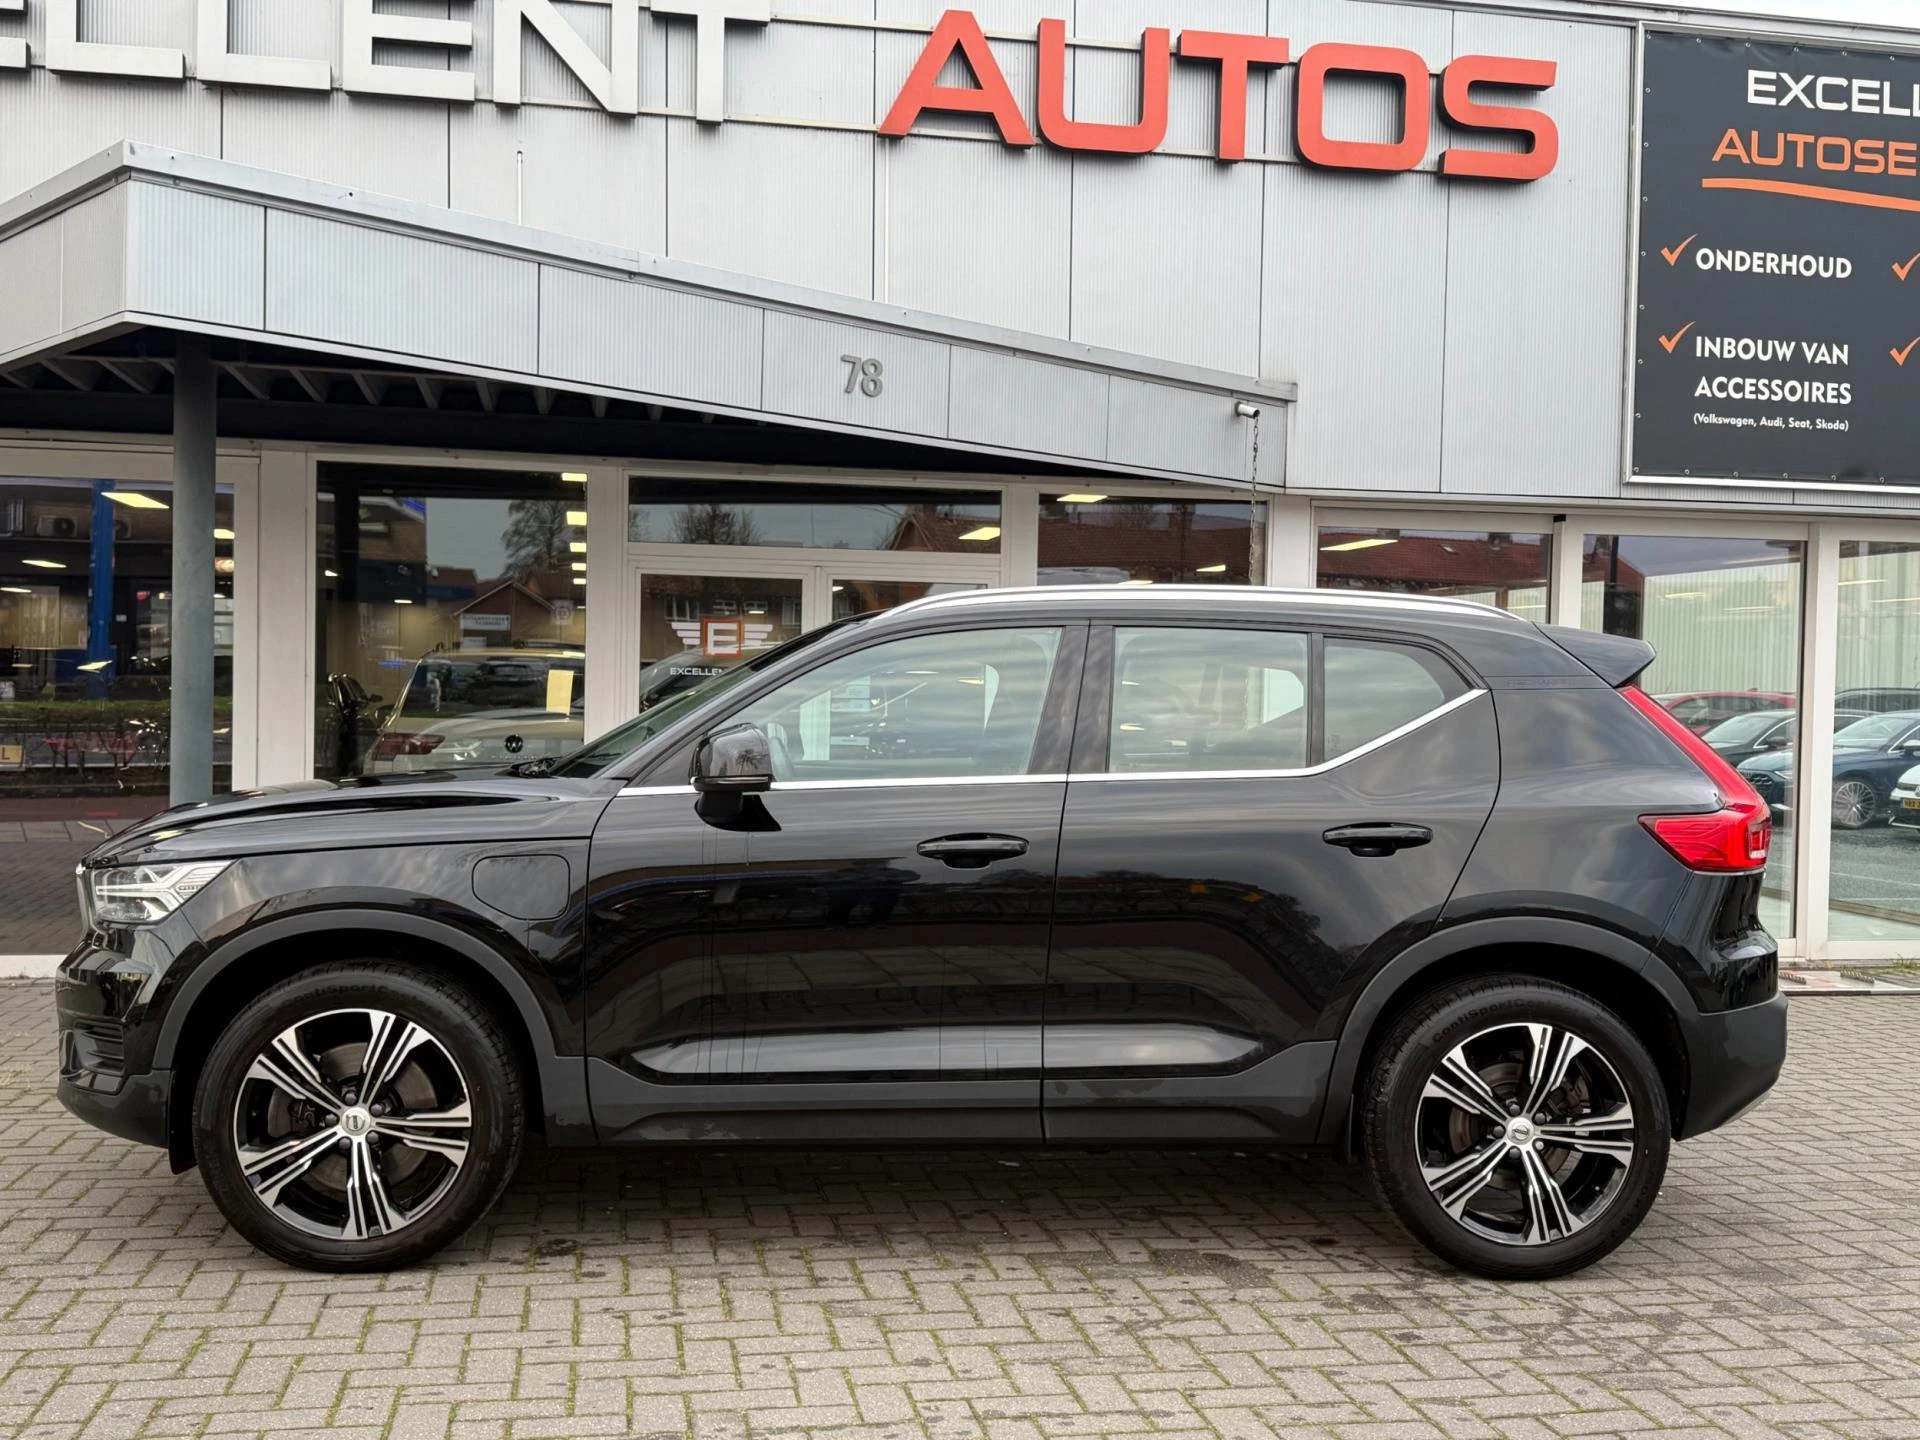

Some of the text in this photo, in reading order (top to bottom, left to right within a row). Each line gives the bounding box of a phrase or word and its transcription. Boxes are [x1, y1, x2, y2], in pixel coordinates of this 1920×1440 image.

[0, 0, 1560, 182] LLENT AUTOS
[1711, 128, 1917, 176] AUTOSE
[1695, 248, 1853, 279] ONDERHOUD
[1696, 336, 1849, 366] INBOUW VAN
[841, 354, 883, 398] 78
[1694, 375, 1852, 405] ACCESSOIRES
[1693, 412, 1849, 432] (Volkswagen, Audi, Seat, Skoda)
